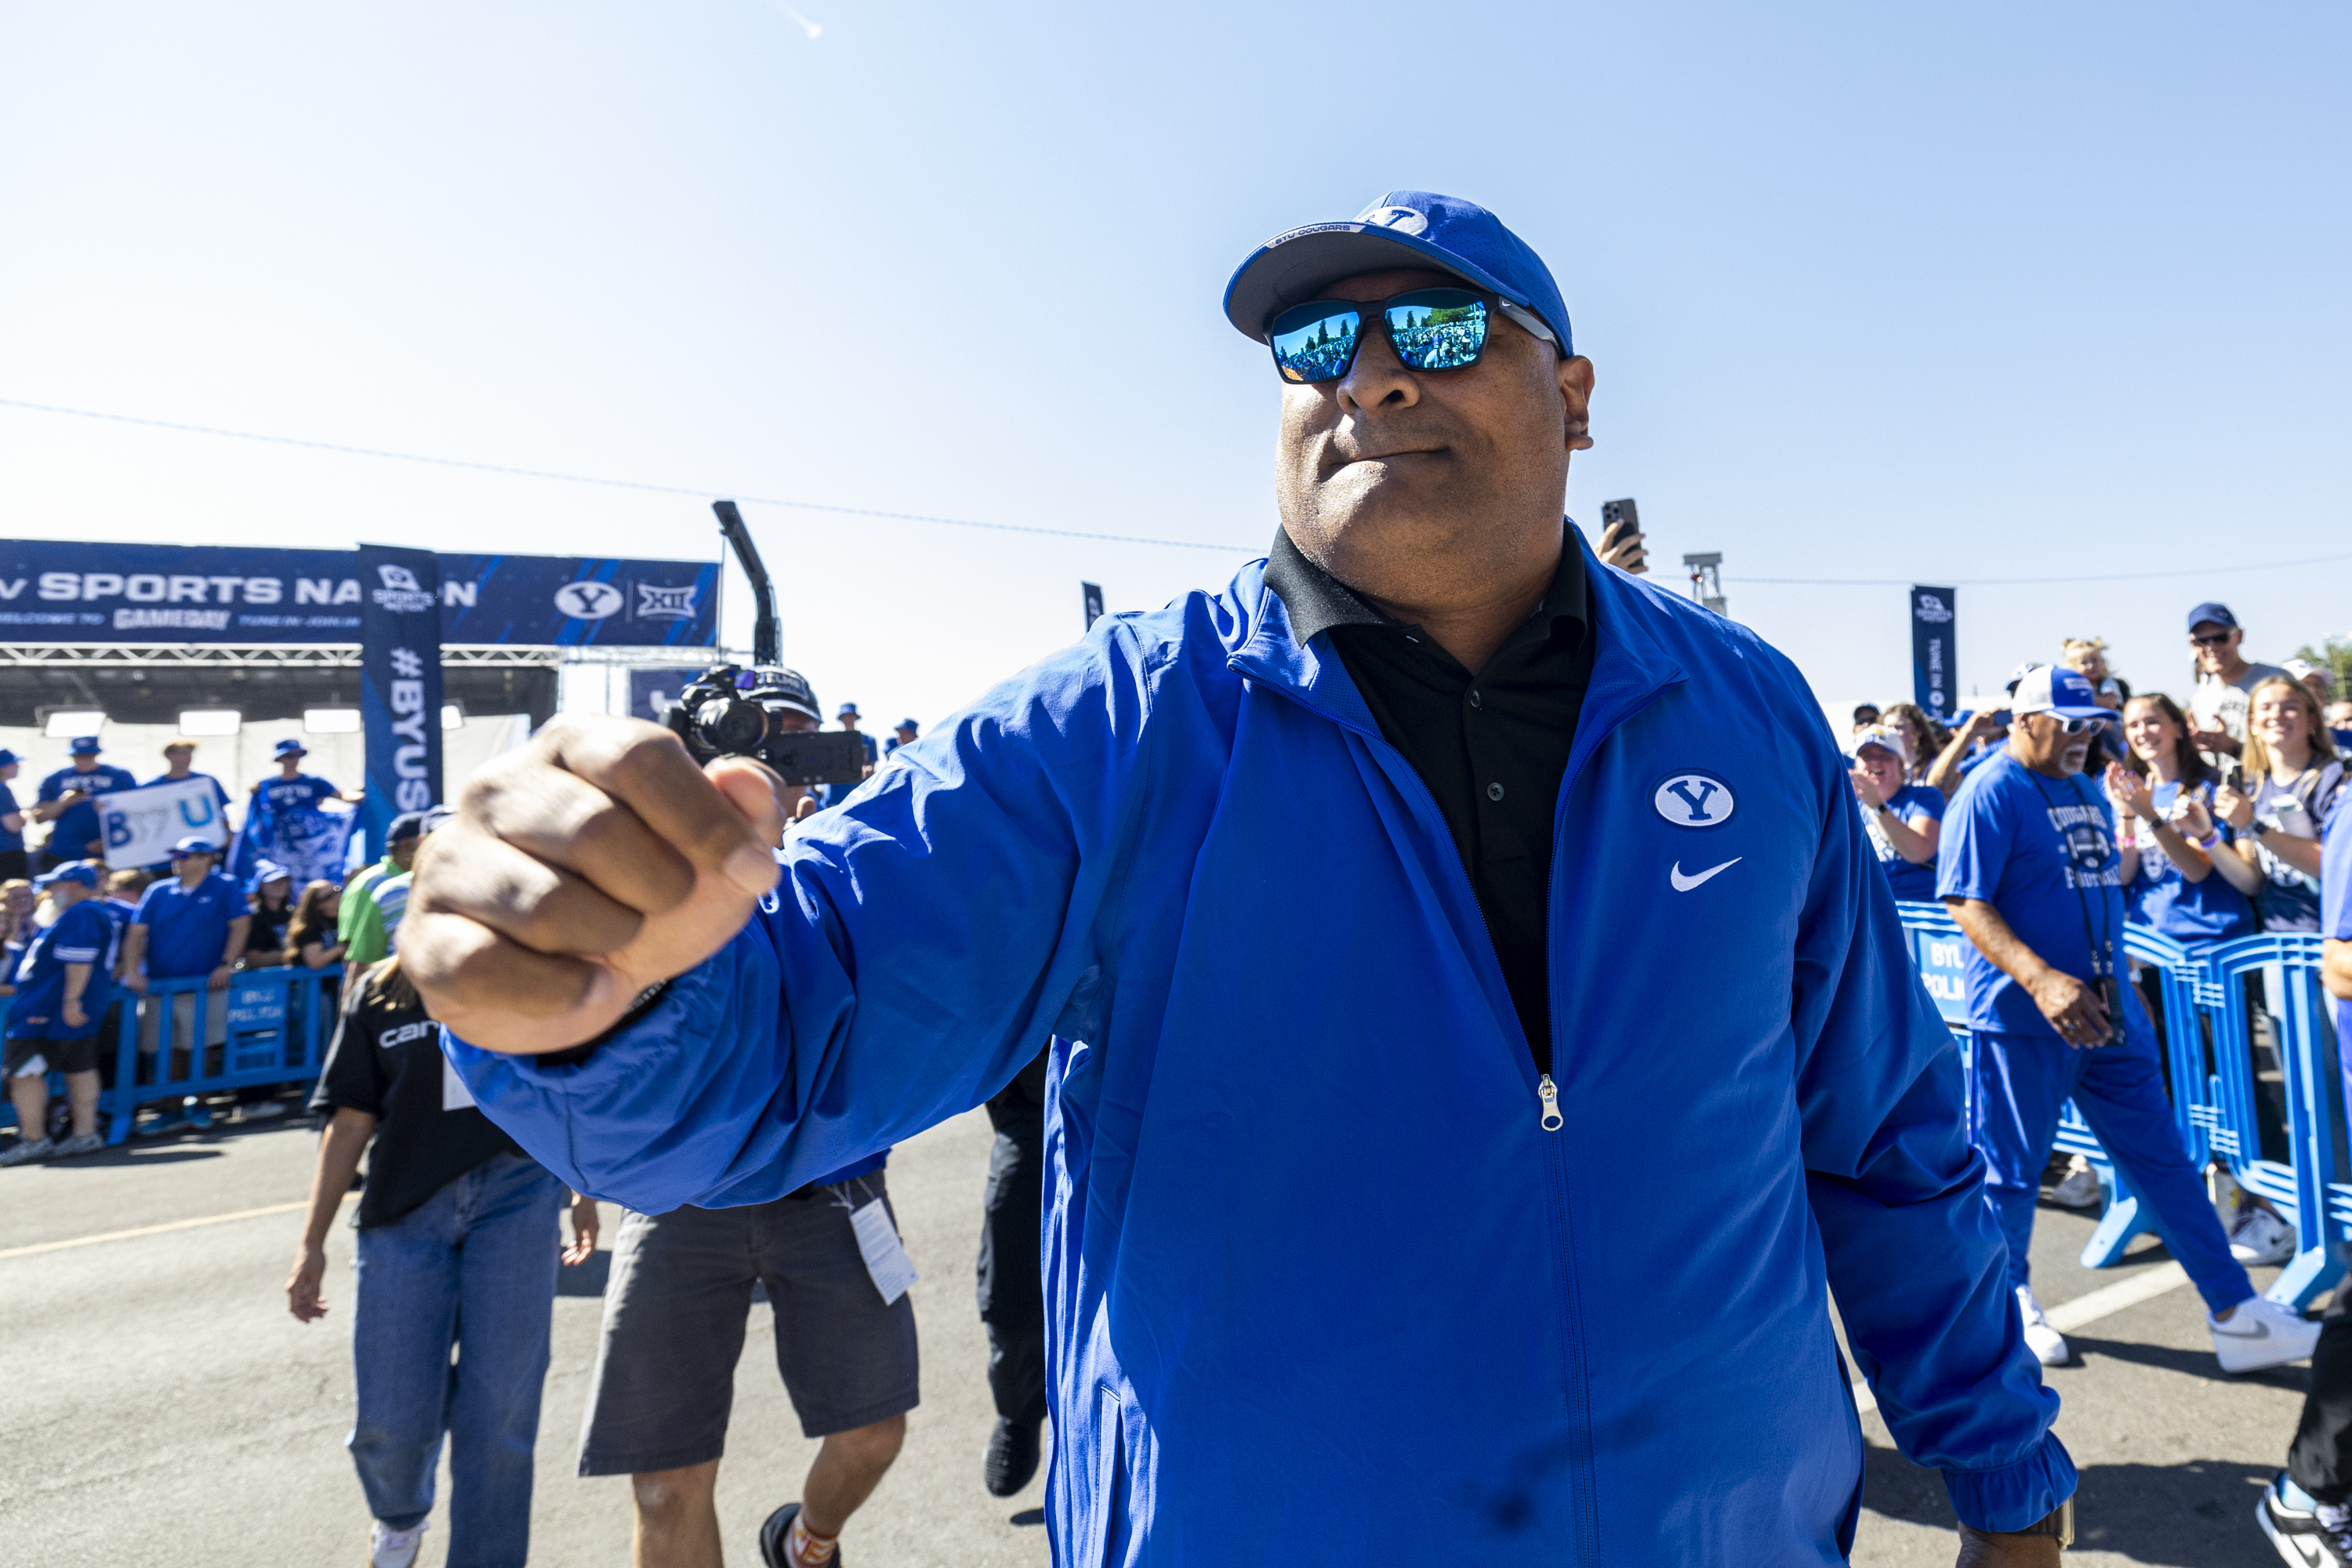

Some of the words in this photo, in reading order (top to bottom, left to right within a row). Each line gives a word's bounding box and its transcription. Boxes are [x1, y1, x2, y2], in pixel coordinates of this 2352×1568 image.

[1276, 232, 1295, 245] BYU
[1298, 223, 1351, 236] COUGARS
[38, 572, 284, 604] SPORTS
[568, 587, 610, 614] Y
[1928, 637, 1942, 672] TUNE
[1930, 673, 1943, 688] IN
[1666, 779, 1719, 821] Y
[1920, 972, 1965, 1001] POLI
